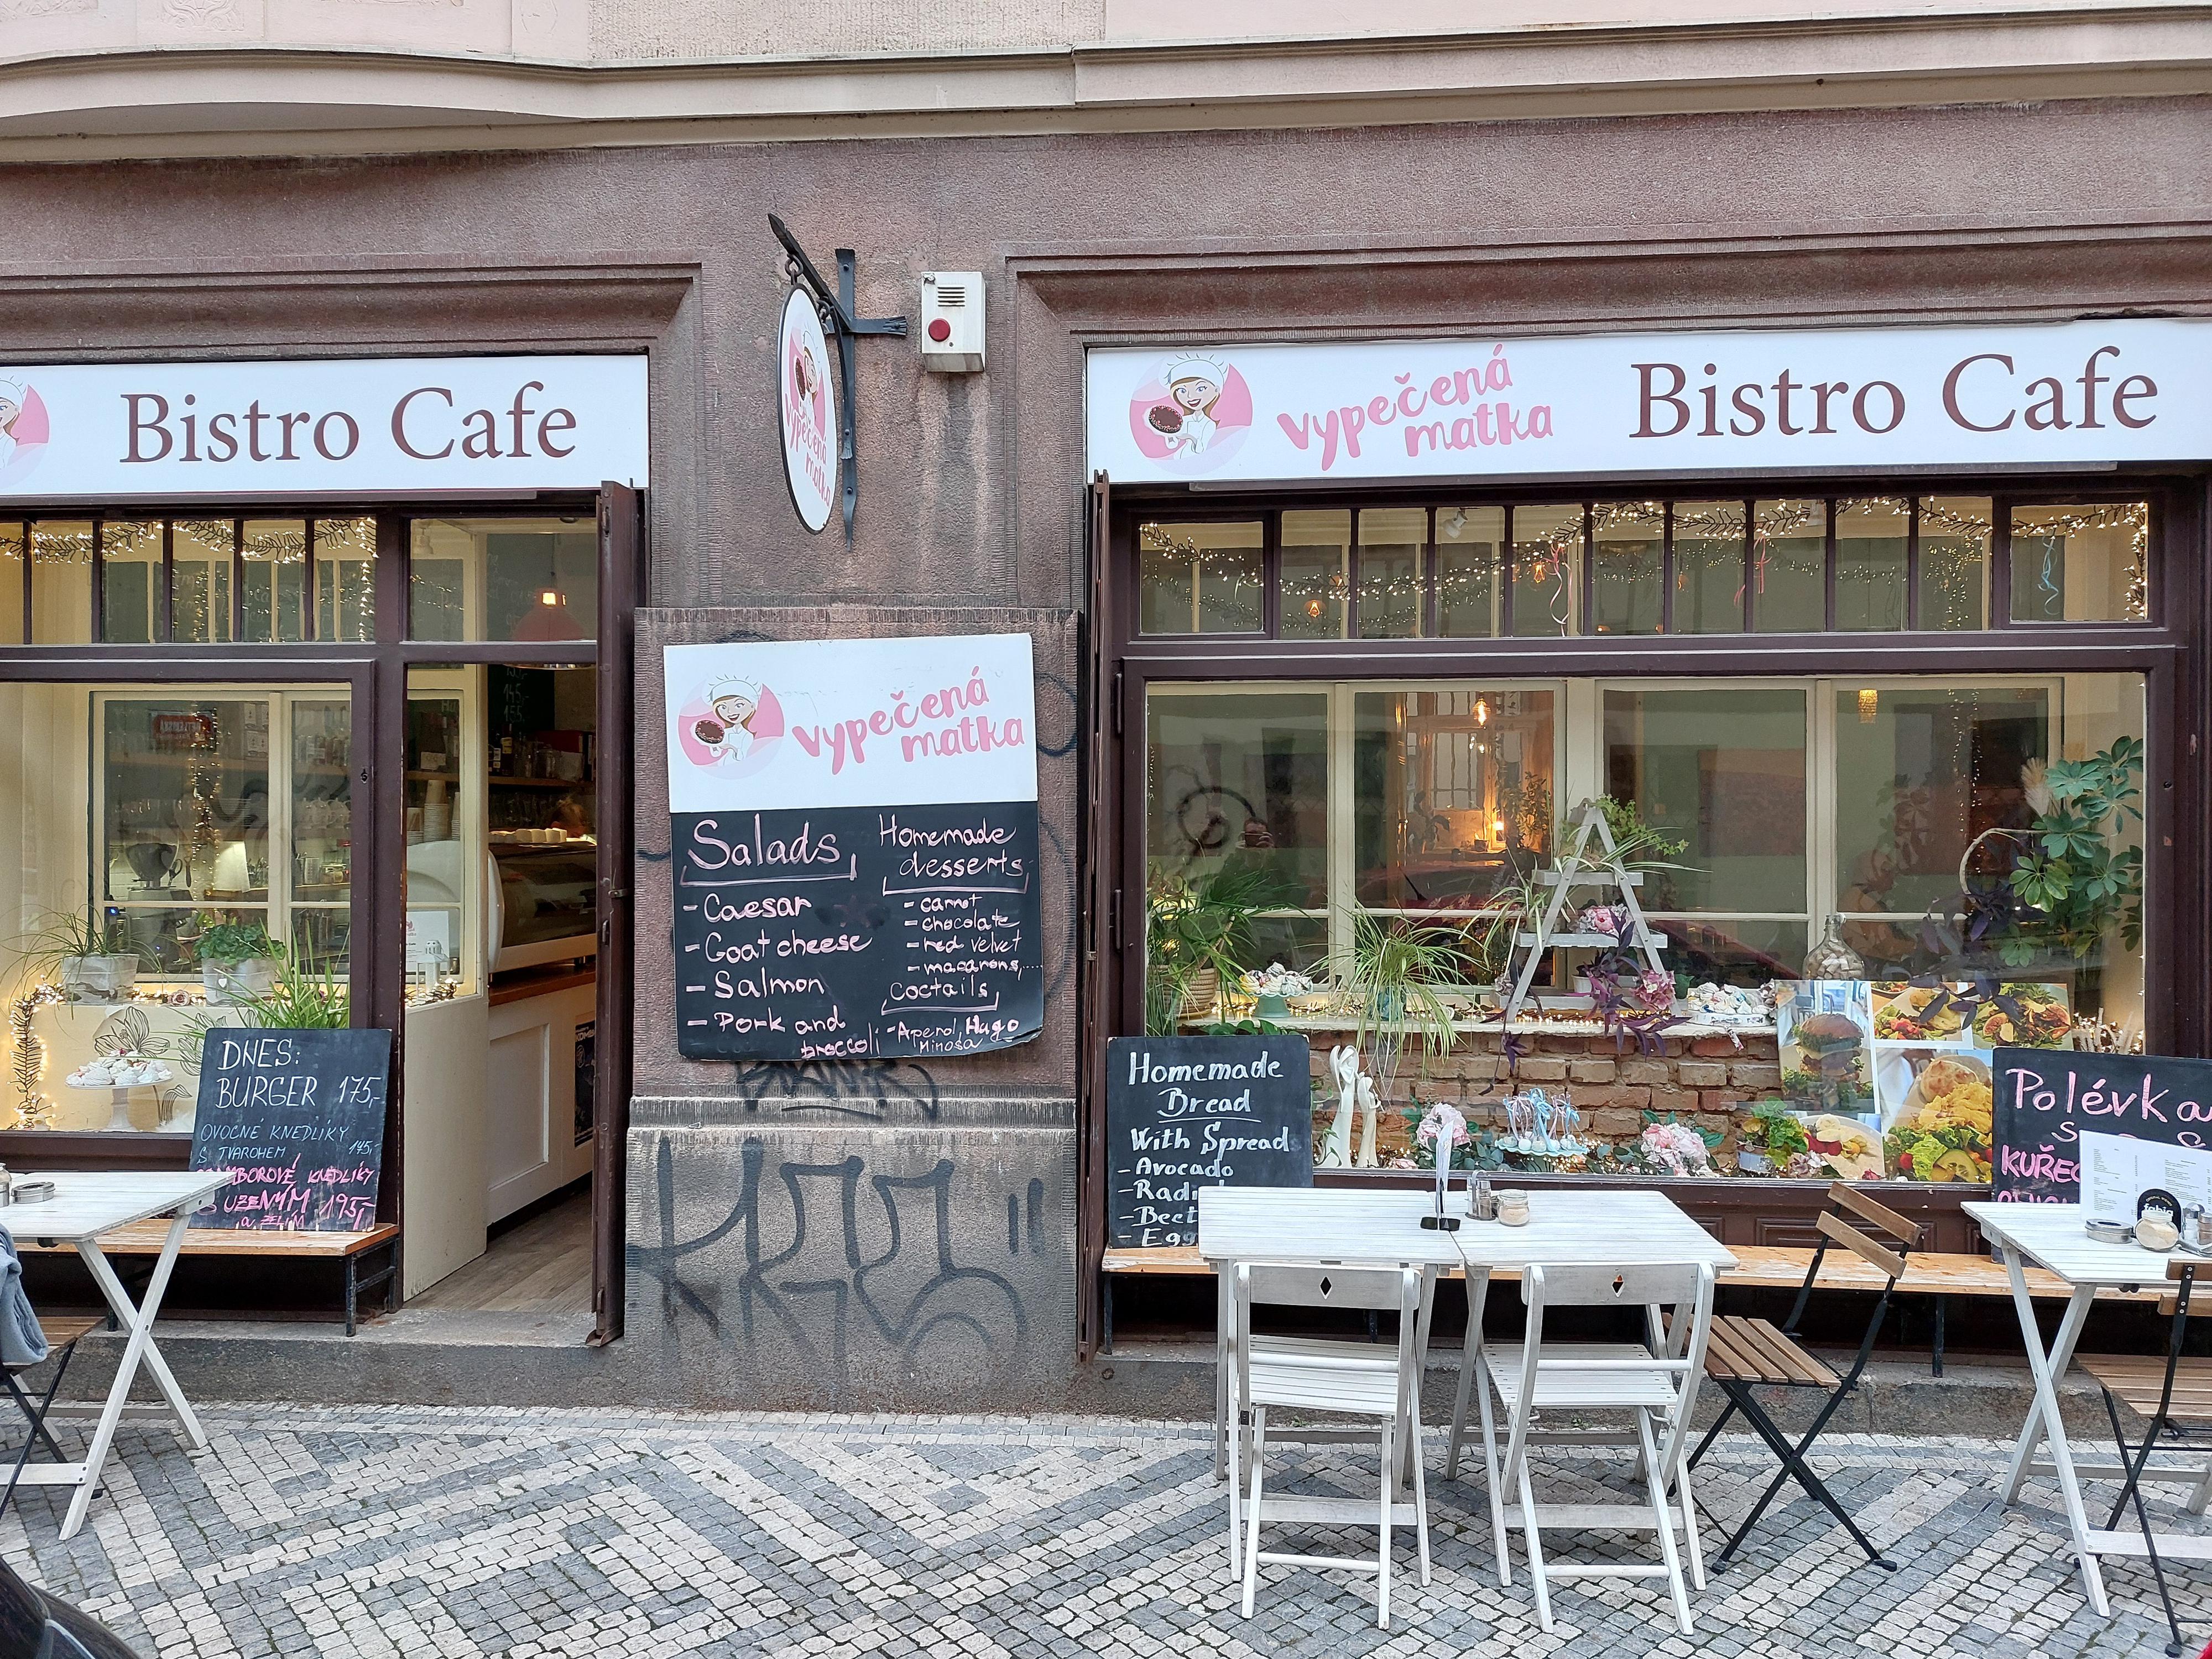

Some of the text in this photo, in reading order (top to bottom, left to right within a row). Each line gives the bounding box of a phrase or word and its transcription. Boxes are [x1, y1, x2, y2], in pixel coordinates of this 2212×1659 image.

[1277, 343, 1513, 471] vypečená
[1629, 345, 2158, 439] Bistro Cafe
[119, 380, 577, 463] Bistro Cafe
[1404, 401, 1553, 457] matka
[805, 452, 831, 508] matka
[791, 666, 990, 775] vypečená
[901, 716, 1025, 762] matka
[879, 813, 1017, 847] Homemade
[899, 849, 1024, 878] desserts
[704, 893, 812, 922] Caesar
[922, 908, 1020, 932] chocolate
[706, 929, 771, 964] Goat
[777, 929, 873, 957] cheese
[924, 935, 965, 953] red
[714, 967, 825, 999] Salmon
[714, 1007, 785, 1033] Pork
[795, 1005, 846, 1035] and
[965, 1015, 1020, 1042] Hugo
[217, 1038, 301, 1071] DNES:
[801, 1022, 880, 1060] broccoli
[1128, 1051, 1284, 1085] Homemade
[215, 1076, 317, 1108] BURGER
[1157, 1087, 1251, 1117] Bread
[200, 1117, 349, 1142] OVOCNÉ KNEDLÍKY
[1130, 1121, 1290, 1161] With Spread
[196, 1152, 375, 1185] BOROVÉ KNEDLÍKY
[219, 1146, 286, 1161] TVAROHEM
[1135, 1156, 1234, 1177] Avocado
[223, 1183, 311, 1214] UZENÝM
